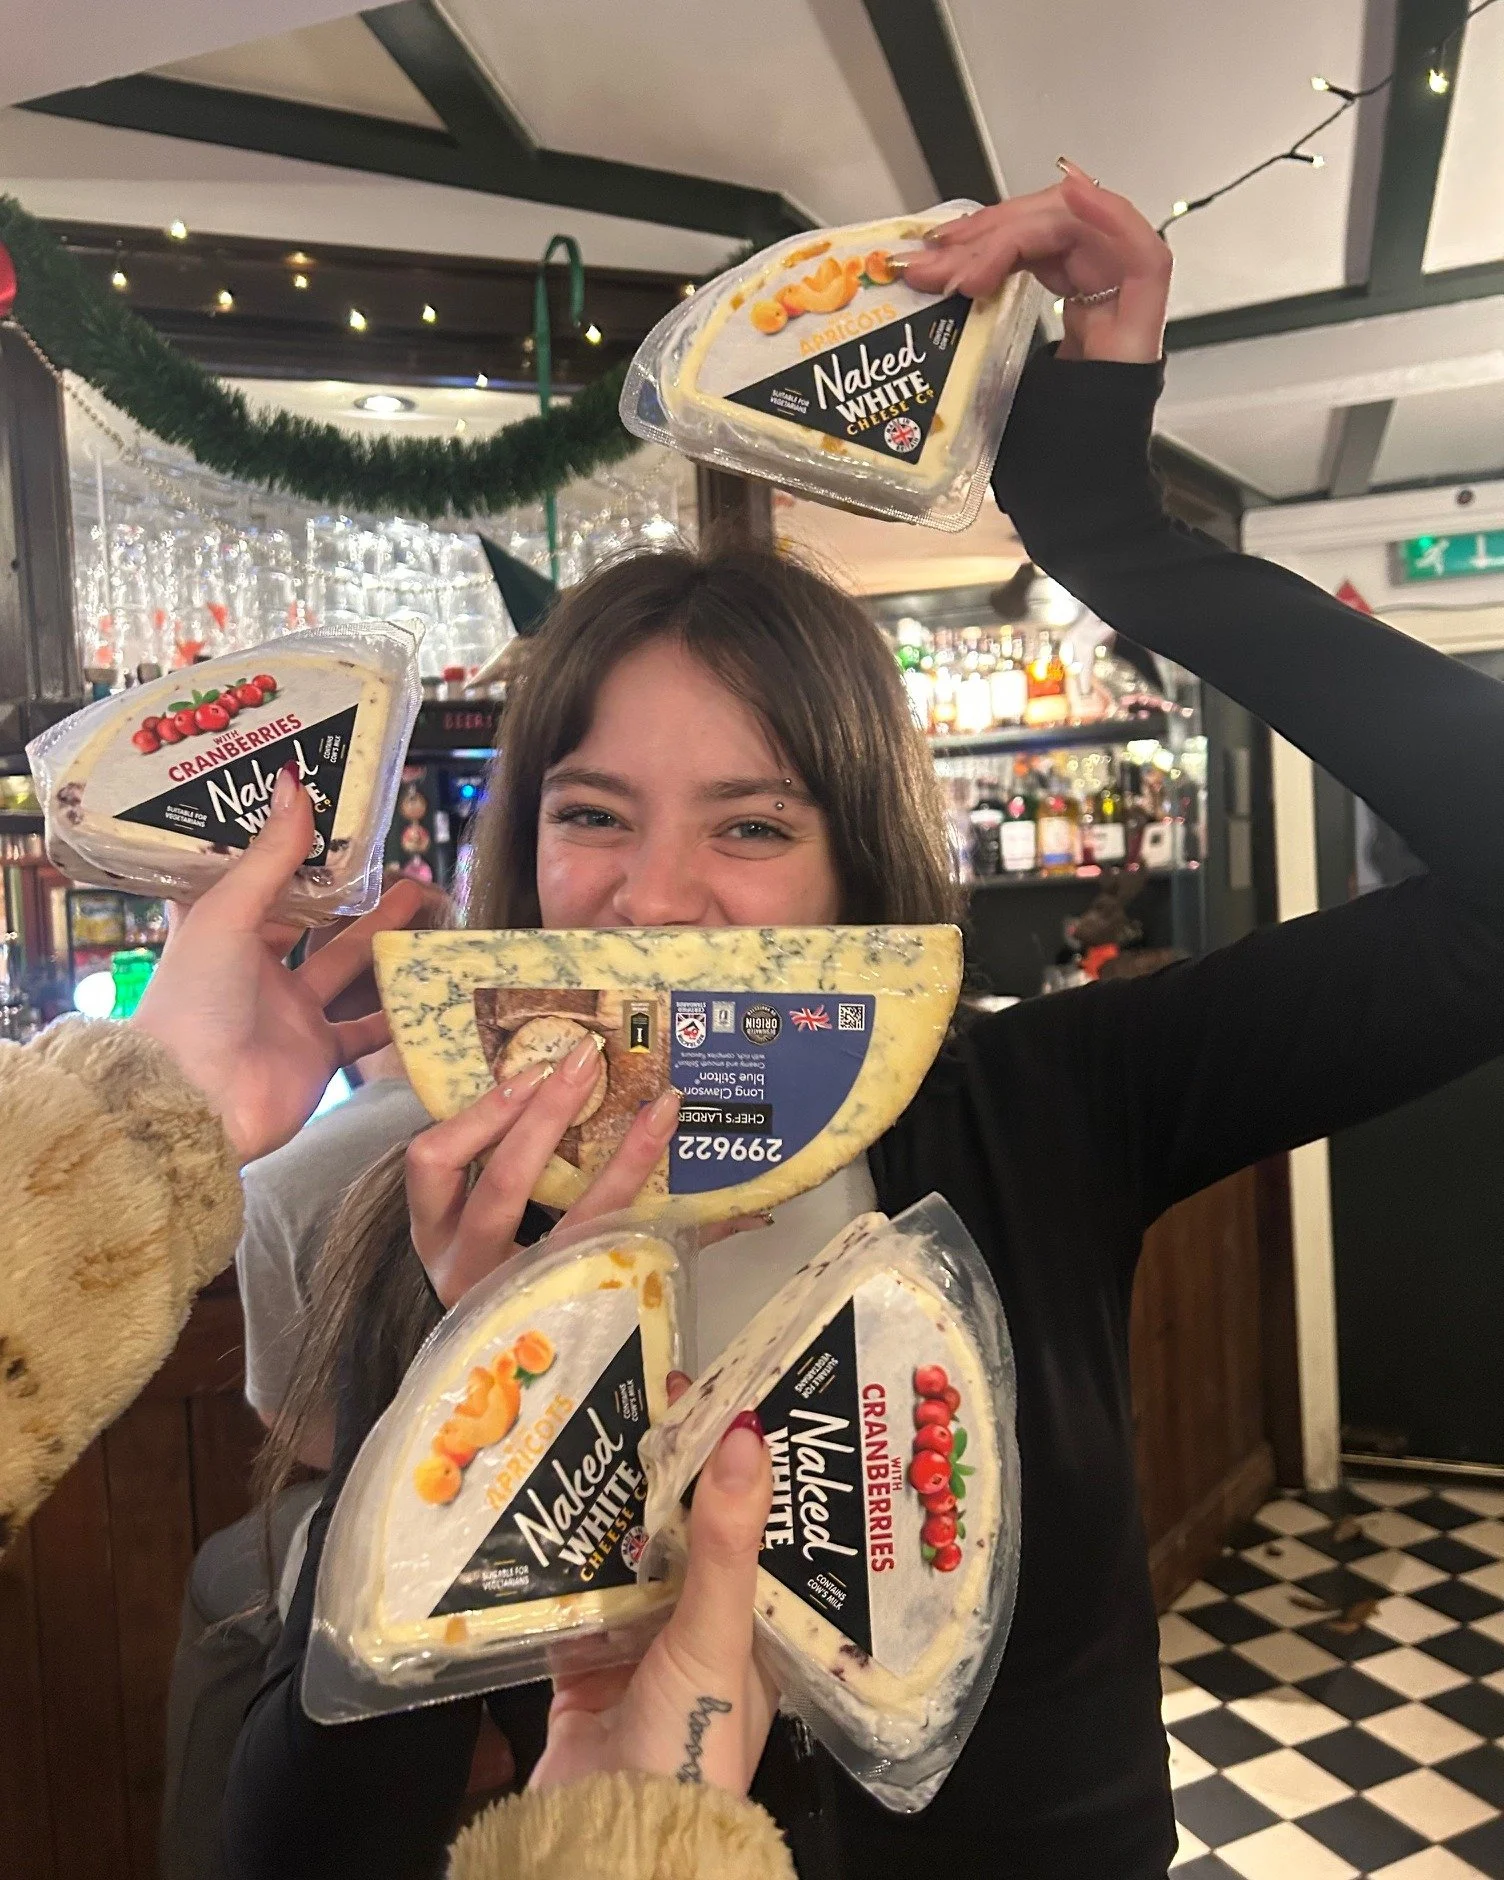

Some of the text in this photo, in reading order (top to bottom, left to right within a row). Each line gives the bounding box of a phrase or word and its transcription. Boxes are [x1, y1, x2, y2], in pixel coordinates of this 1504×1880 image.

[800, 303, 898, 356] APRICOTS
[813, 323, 926, 410] Naked
[836, 370, 930, 423] WHITE
[846, 399, 909, 436] CHEESE
[168, 713, 302, 782] CRANBERRIES
[213, 730, 240, 746] WITH
[206, 739, 319, 823] Nakd
[745, 1017, 778, 1029] ORIGIN
[684, 1086, 764, 1100] Long Clawson
[739, 1073, 765, 1085] blue
[679, 1111, 765, 1124] CHEF'S LARDER
[678, 1135, 783, 1162] 299622
[801, 1383, 816, 1399] FOR
[486, 1392, 575, 1512] APRICOTS
[890, 1456, 902, 1492] WITH
[513, 1407, 623, 1568] Naked
[789, 1408, 859, 1562] Naked
[861, 1382, 895, 1573] CRANBERRIES
[558, 1461, 643, 1566] WHITE
[580, 1507, 635, 1583] CHEESE
[807, 1578, 845, 1611] COW'S MILK
[816, 1573, 847, 1601] CONTAINS
